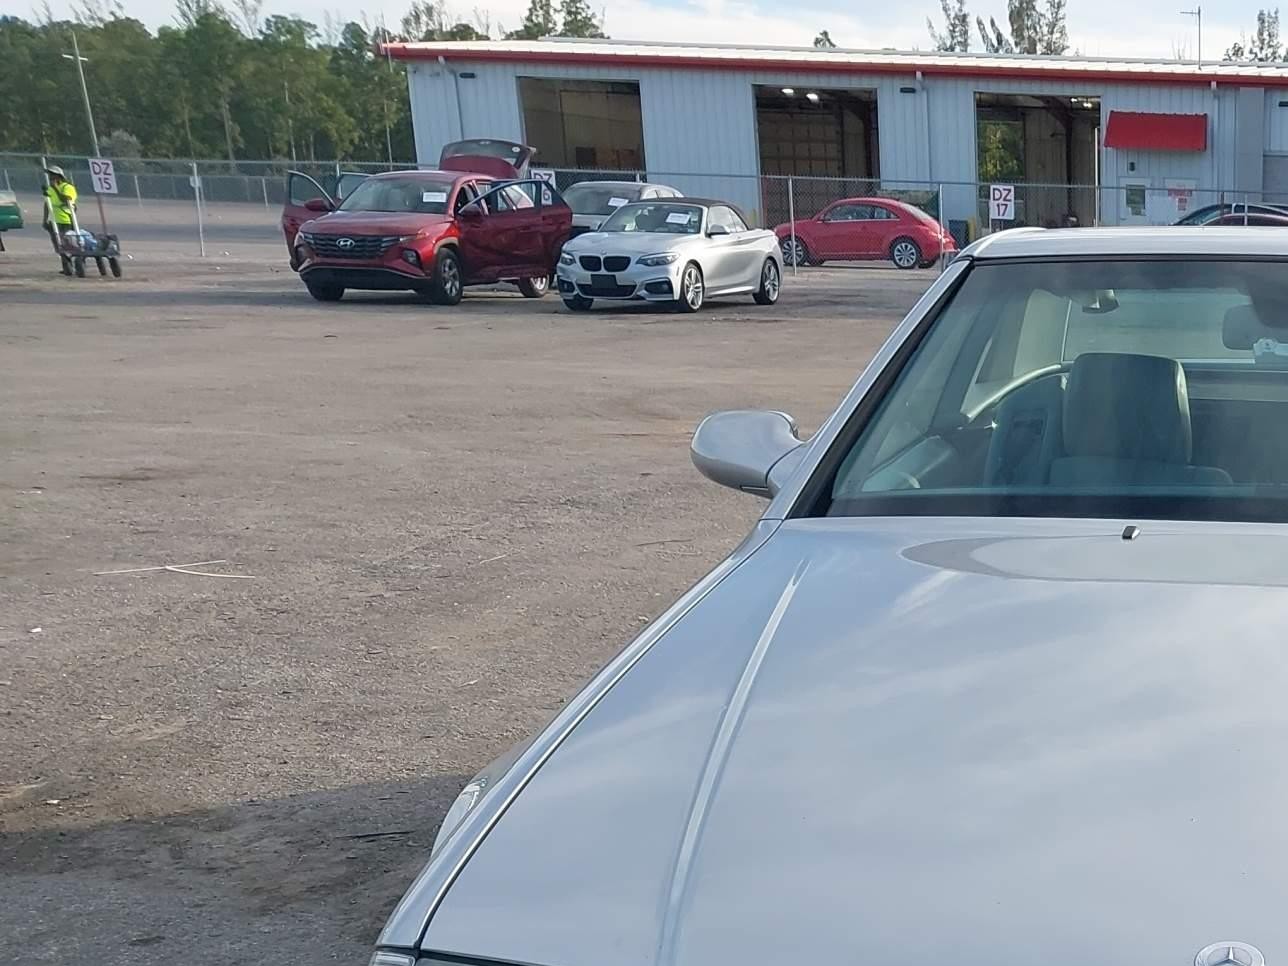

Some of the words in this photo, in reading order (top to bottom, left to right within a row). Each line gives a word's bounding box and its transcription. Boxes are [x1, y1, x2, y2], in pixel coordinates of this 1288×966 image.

[91, 161, 112, 176] DZ
[98, 177, 112, 191] 15
[992, 187, 1012, 202] DZ
[996, 203, 1008, 217] 17
